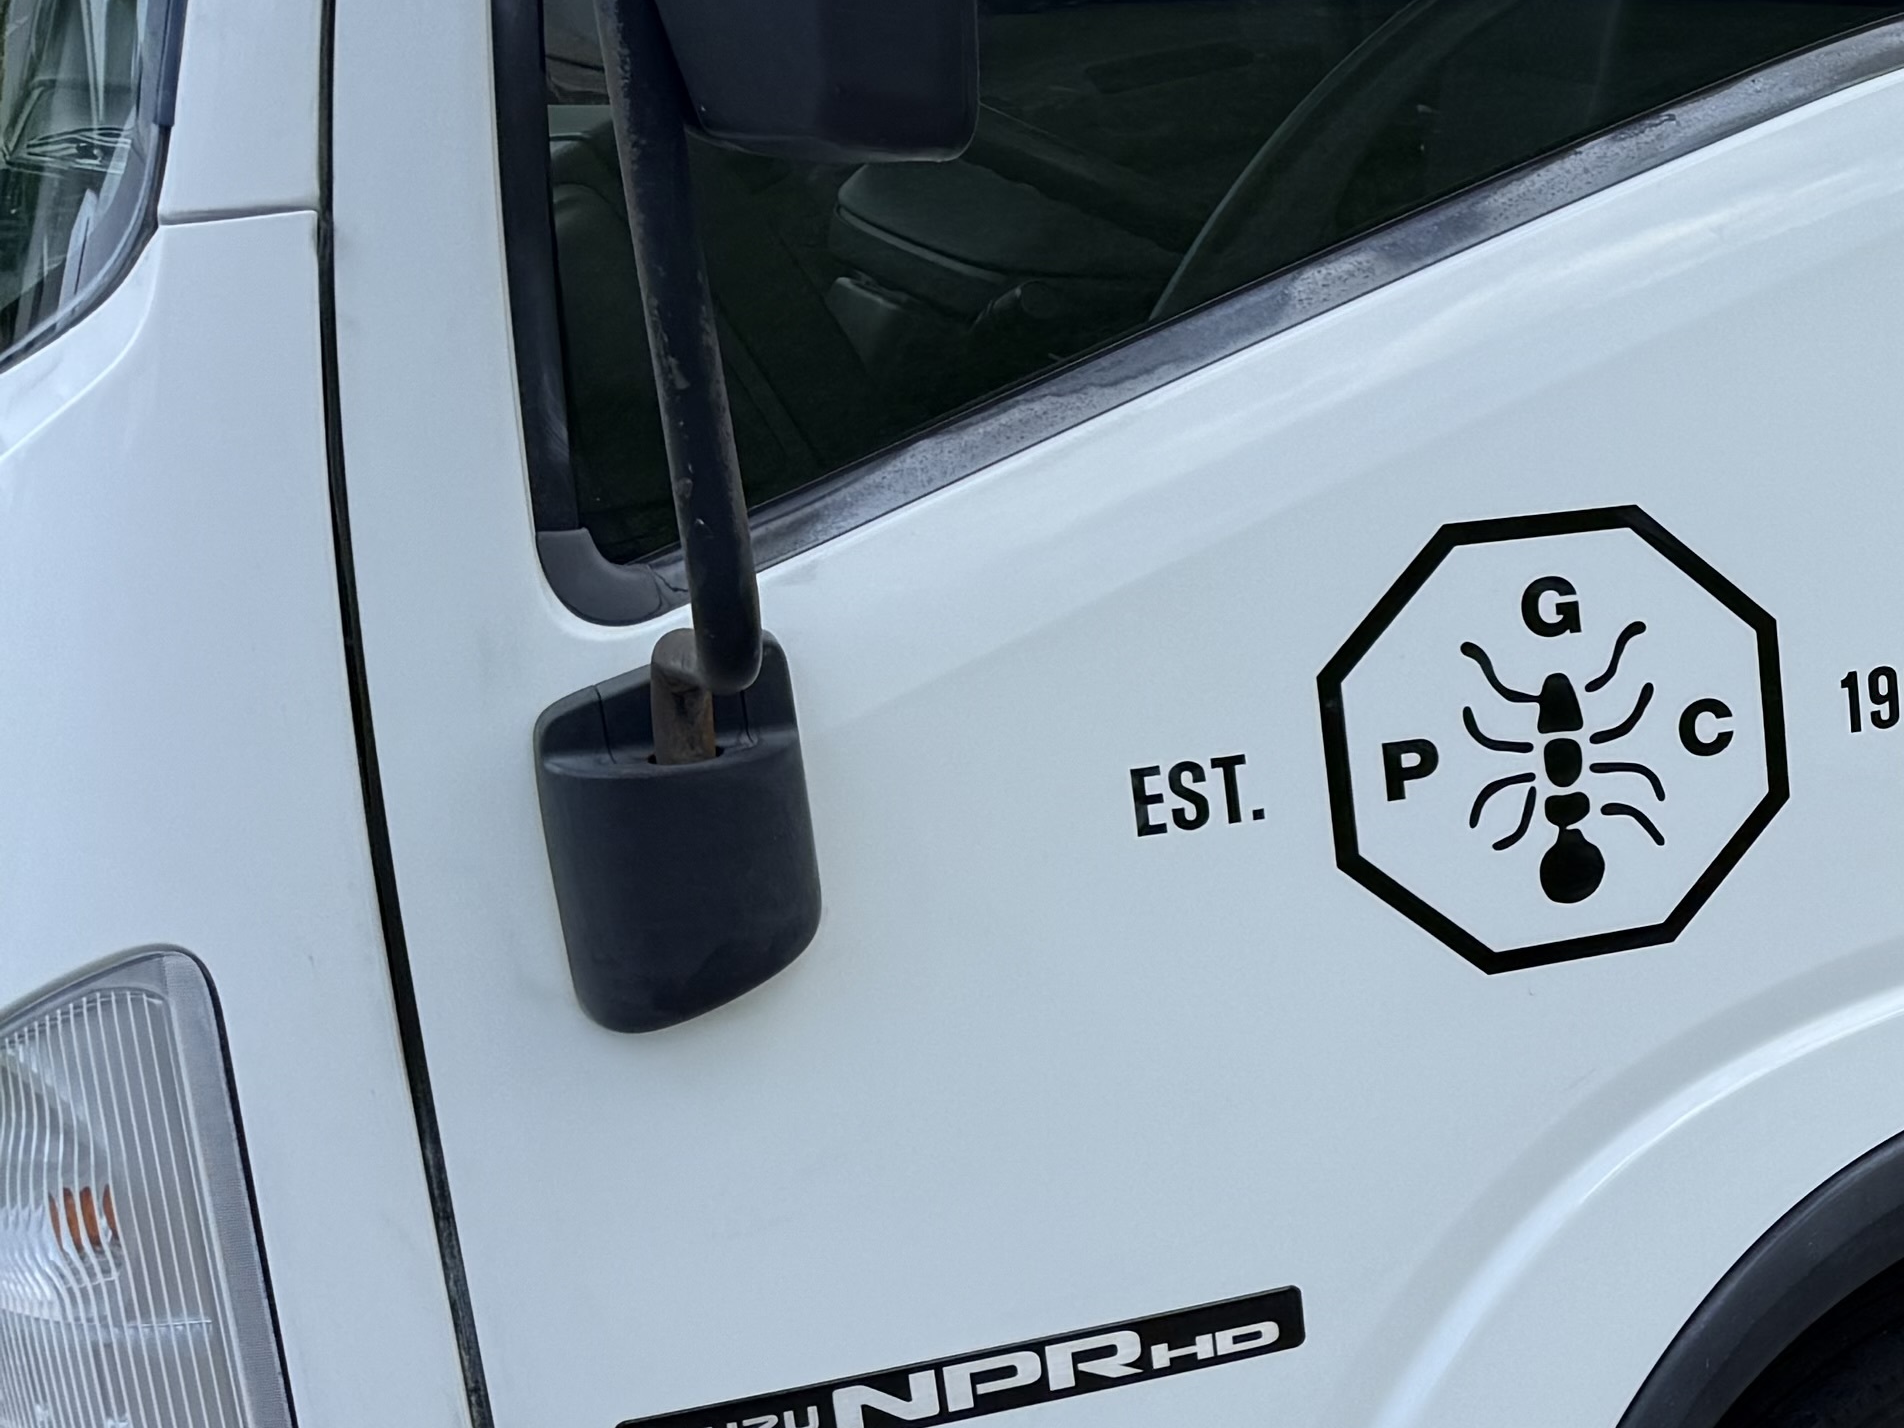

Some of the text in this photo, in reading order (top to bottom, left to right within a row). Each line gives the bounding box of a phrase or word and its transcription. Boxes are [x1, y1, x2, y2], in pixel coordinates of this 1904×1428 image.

[1519, 575, 1583, 639] G
[1130, 753, 1266, 837] EST.
[1382, 737, 1440, 803] P
[1677, 697, 1735, 758] C
[1151, 1320, 1281, 1370] HD
